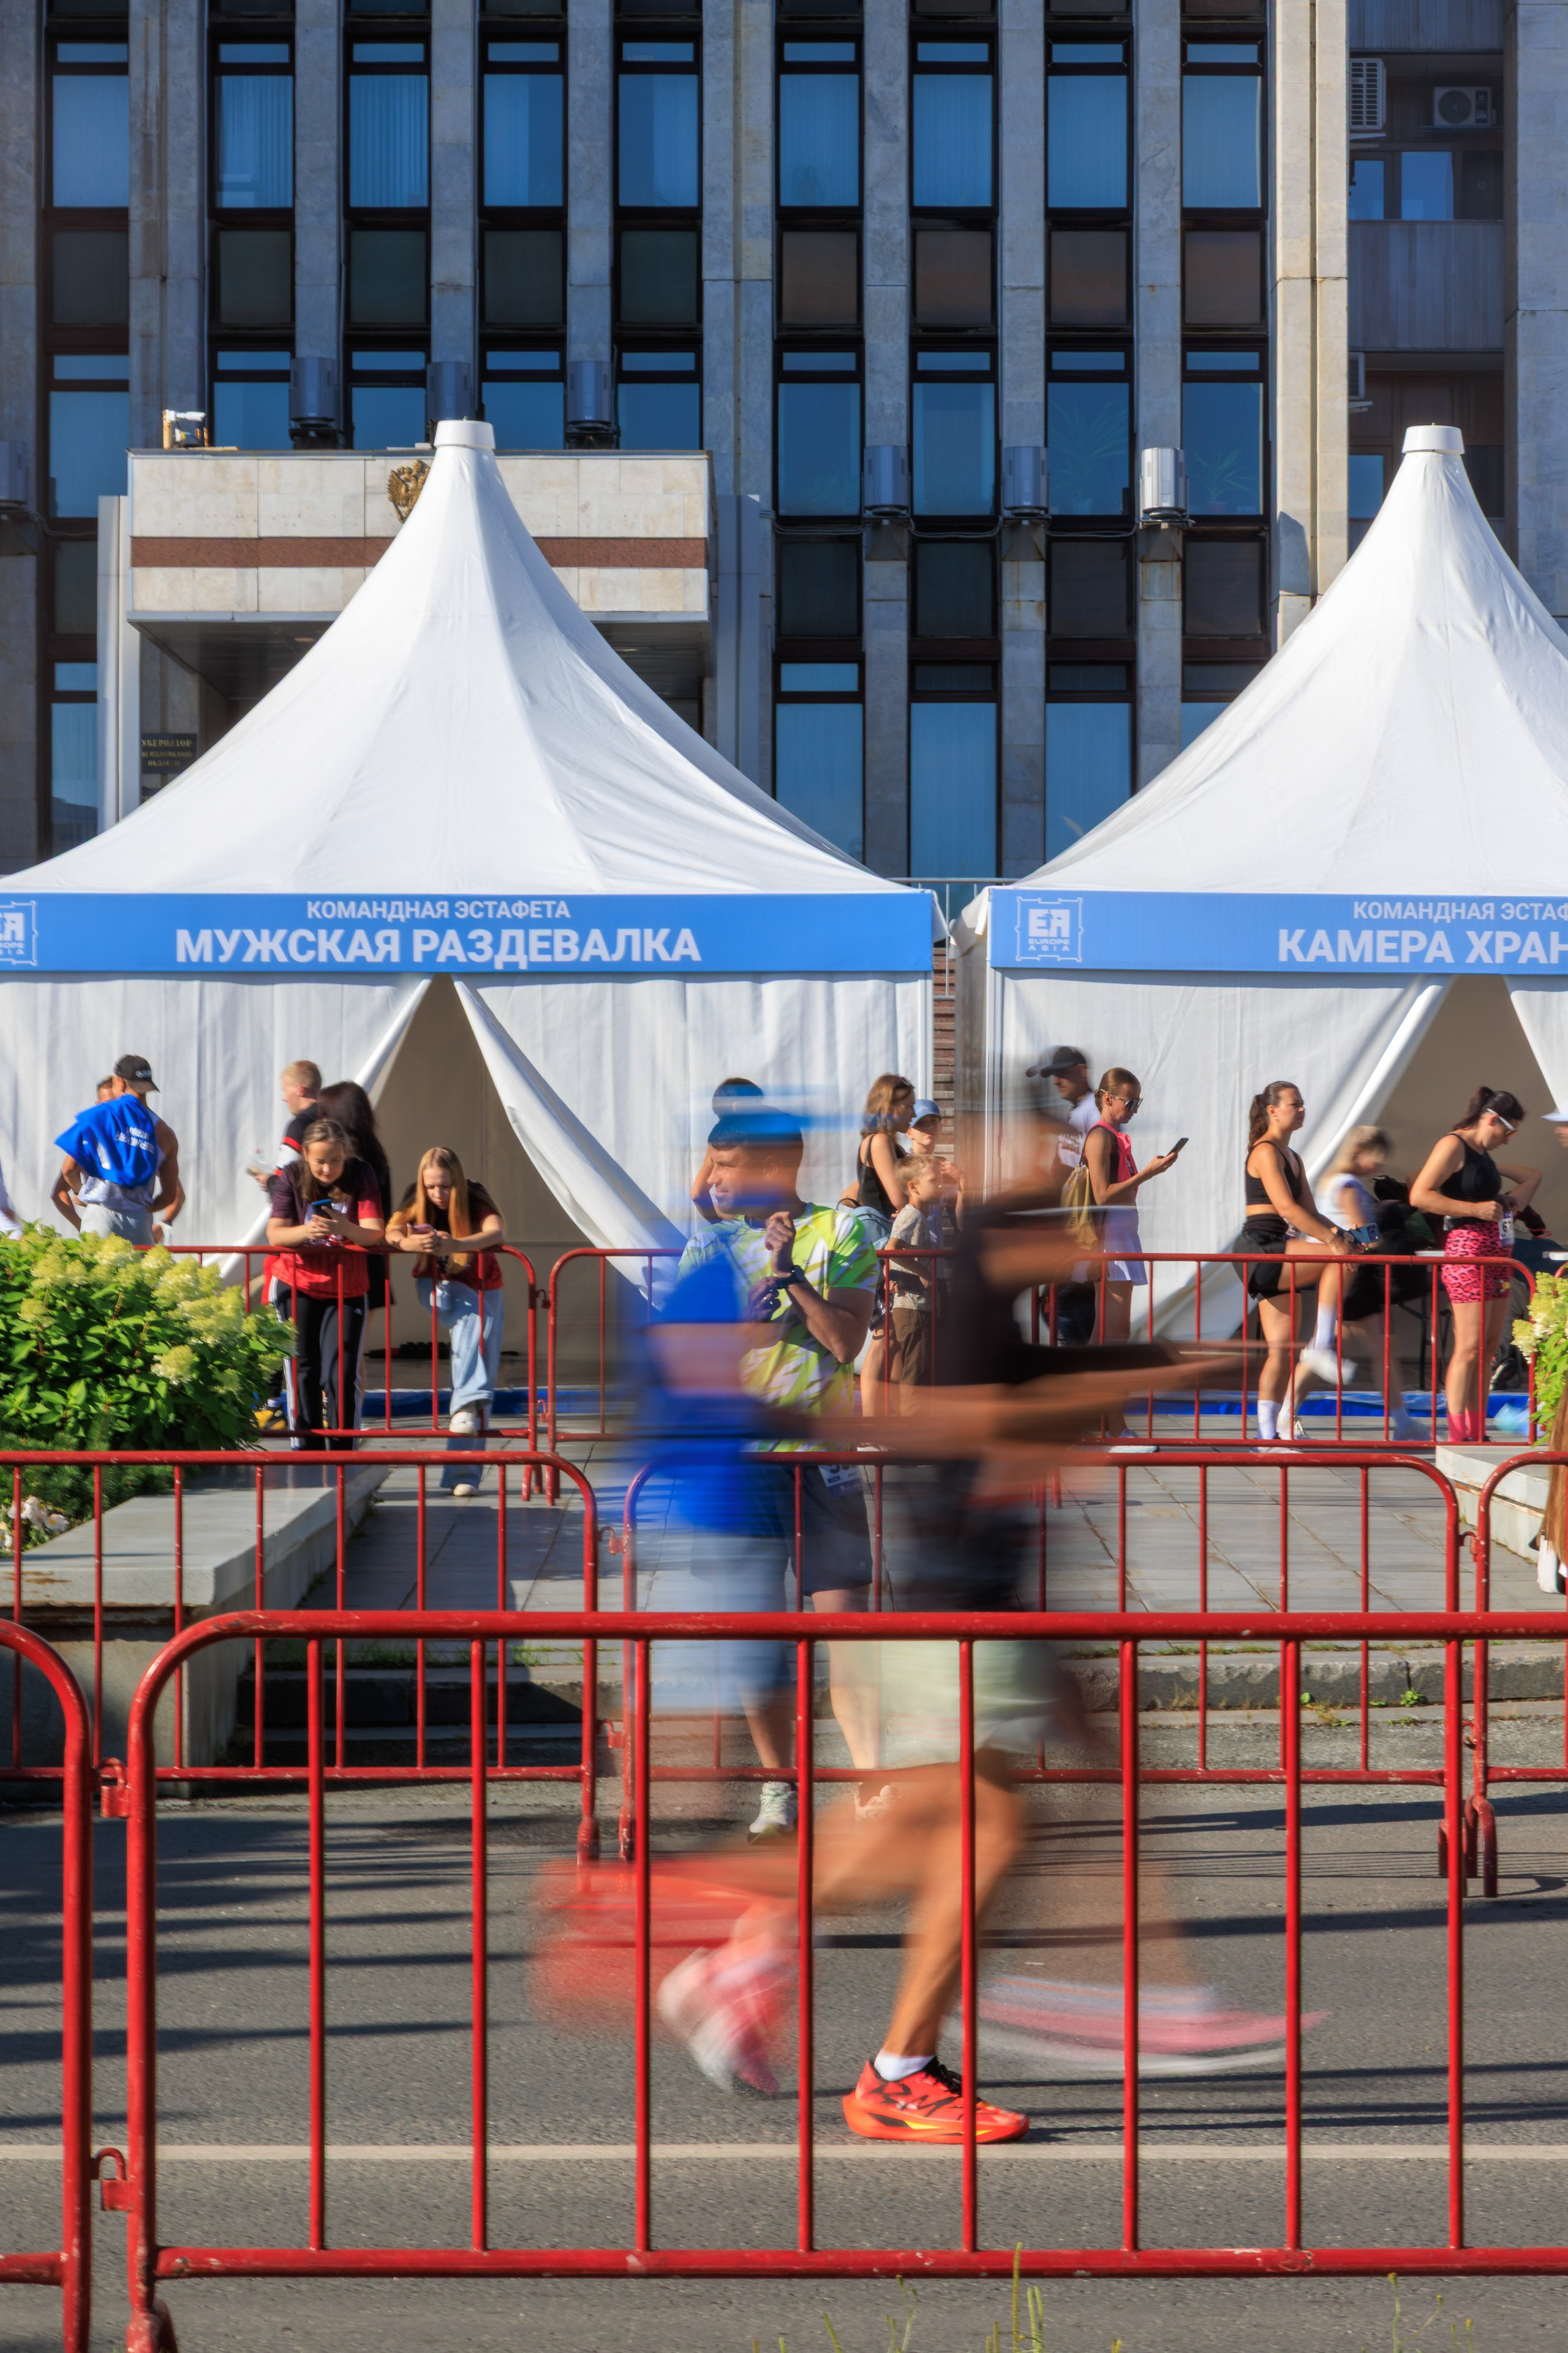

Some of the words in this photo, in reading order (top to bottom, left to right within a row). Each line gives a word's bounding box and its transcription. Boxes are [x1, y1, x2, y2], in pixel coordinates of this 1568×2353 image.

[141, 739, 192, 747] УБЕРНАТОР
[307, 901, 450, 923] КОМАНДНАЯ
[454, 901, 571, 919] ЭСТАФЕТА
[1353, 902, 1495, 924] КОМАНДНАЯ
[176, 929, 401, 963] МУЖСКАЯ
[412, 928, 703, 970] РАЗДЕВАЛКА
[1278, 929, 1455, 964] КАМЕРА
